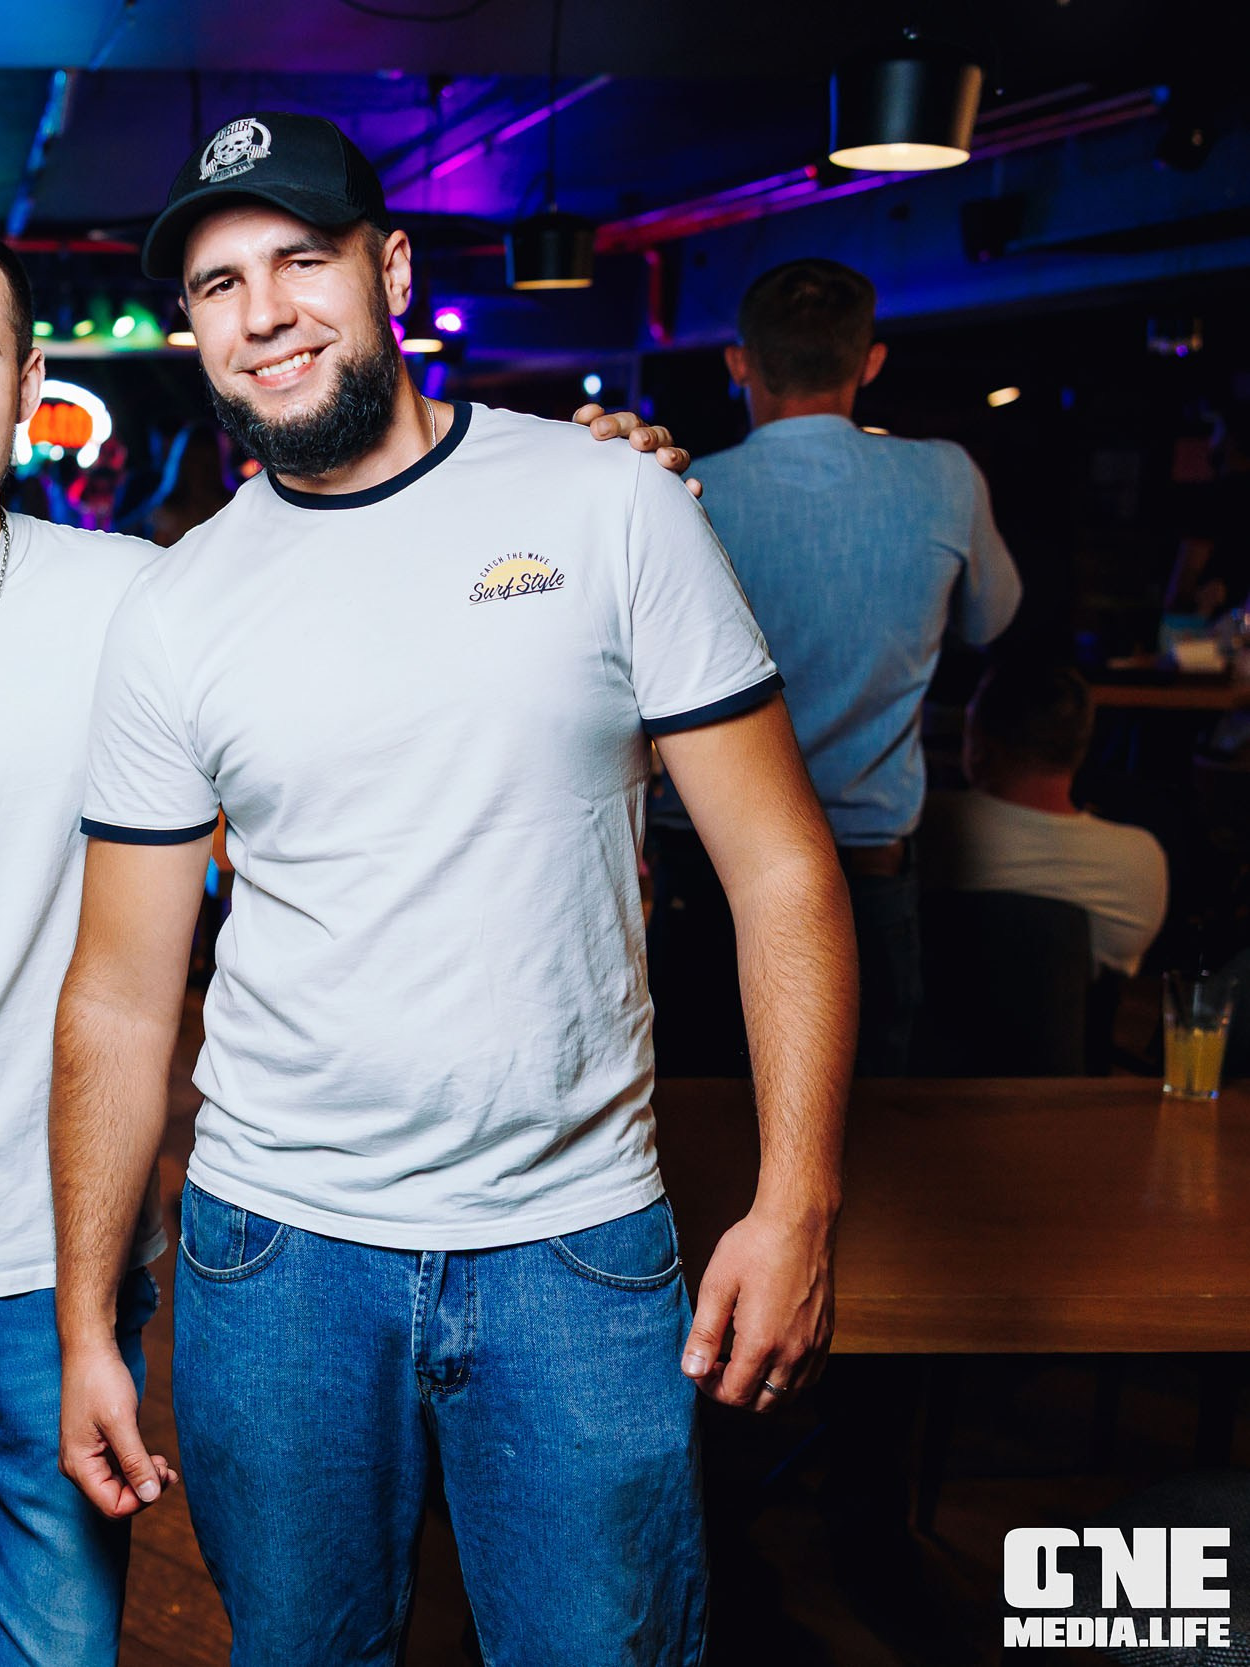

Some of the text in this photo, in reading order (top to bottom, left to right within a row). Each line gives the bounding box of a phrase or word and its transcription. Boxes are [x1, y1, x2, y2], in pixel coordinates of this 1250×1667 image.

[479, 552, 550, 578] CATCH THE WAVE
[469, 567, 565, 602] Surf Style
